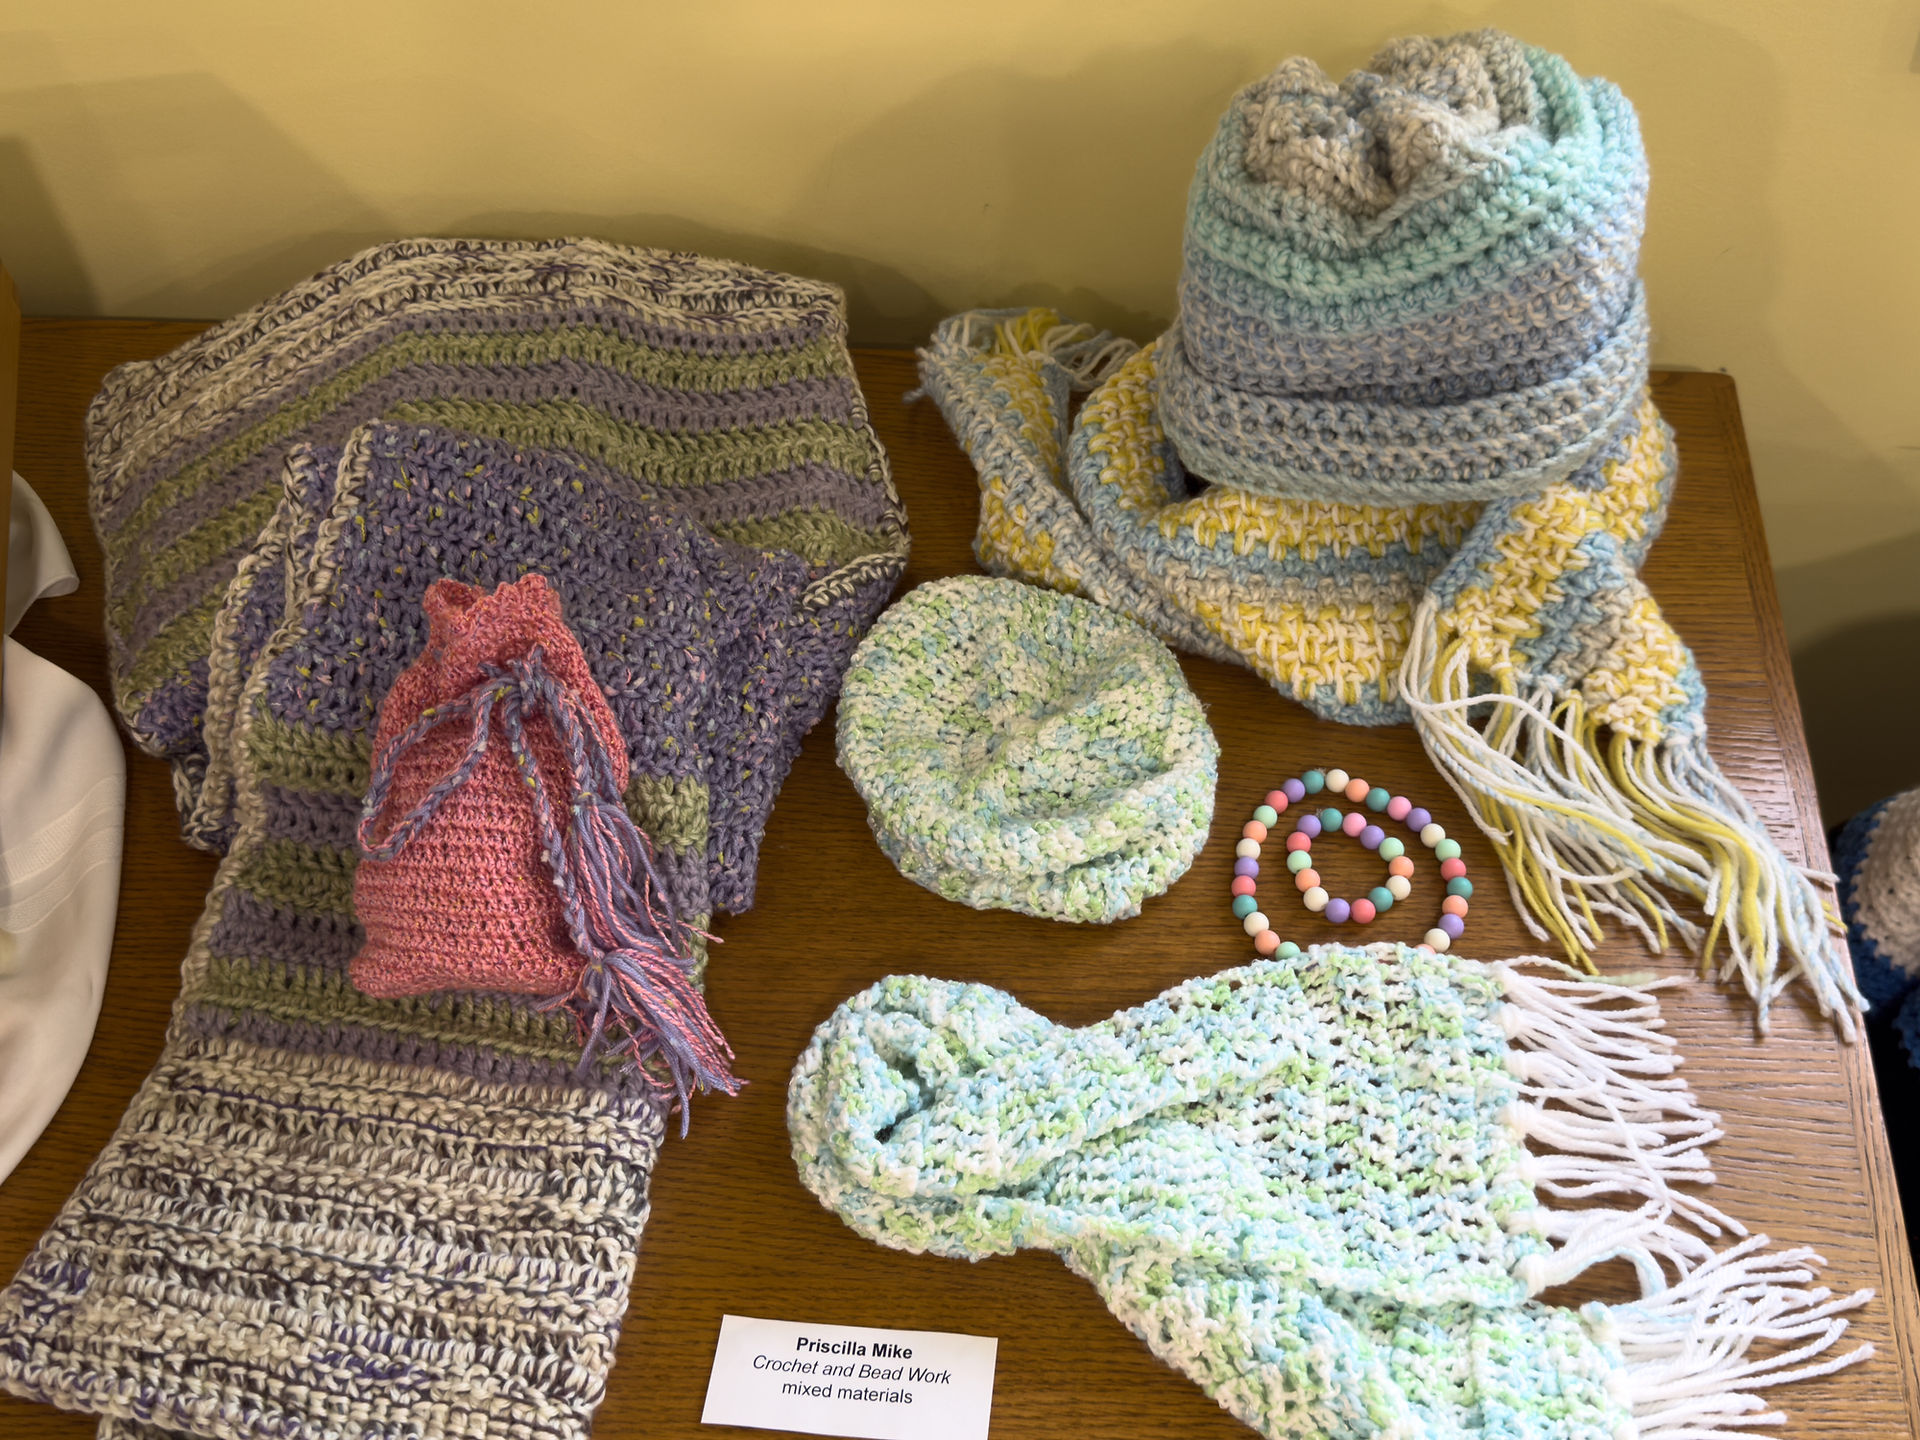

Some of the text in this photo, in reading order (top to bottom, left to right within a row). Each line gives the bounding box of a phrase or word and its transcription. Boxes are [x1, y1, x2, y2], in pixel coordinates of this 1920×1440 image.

[796, 1336, 913, 1359] Priscilla Mike
[753, 1354, 951, 1384] Crochet and Bead Work
[782, 1382, 913, 1404] mixed materials
